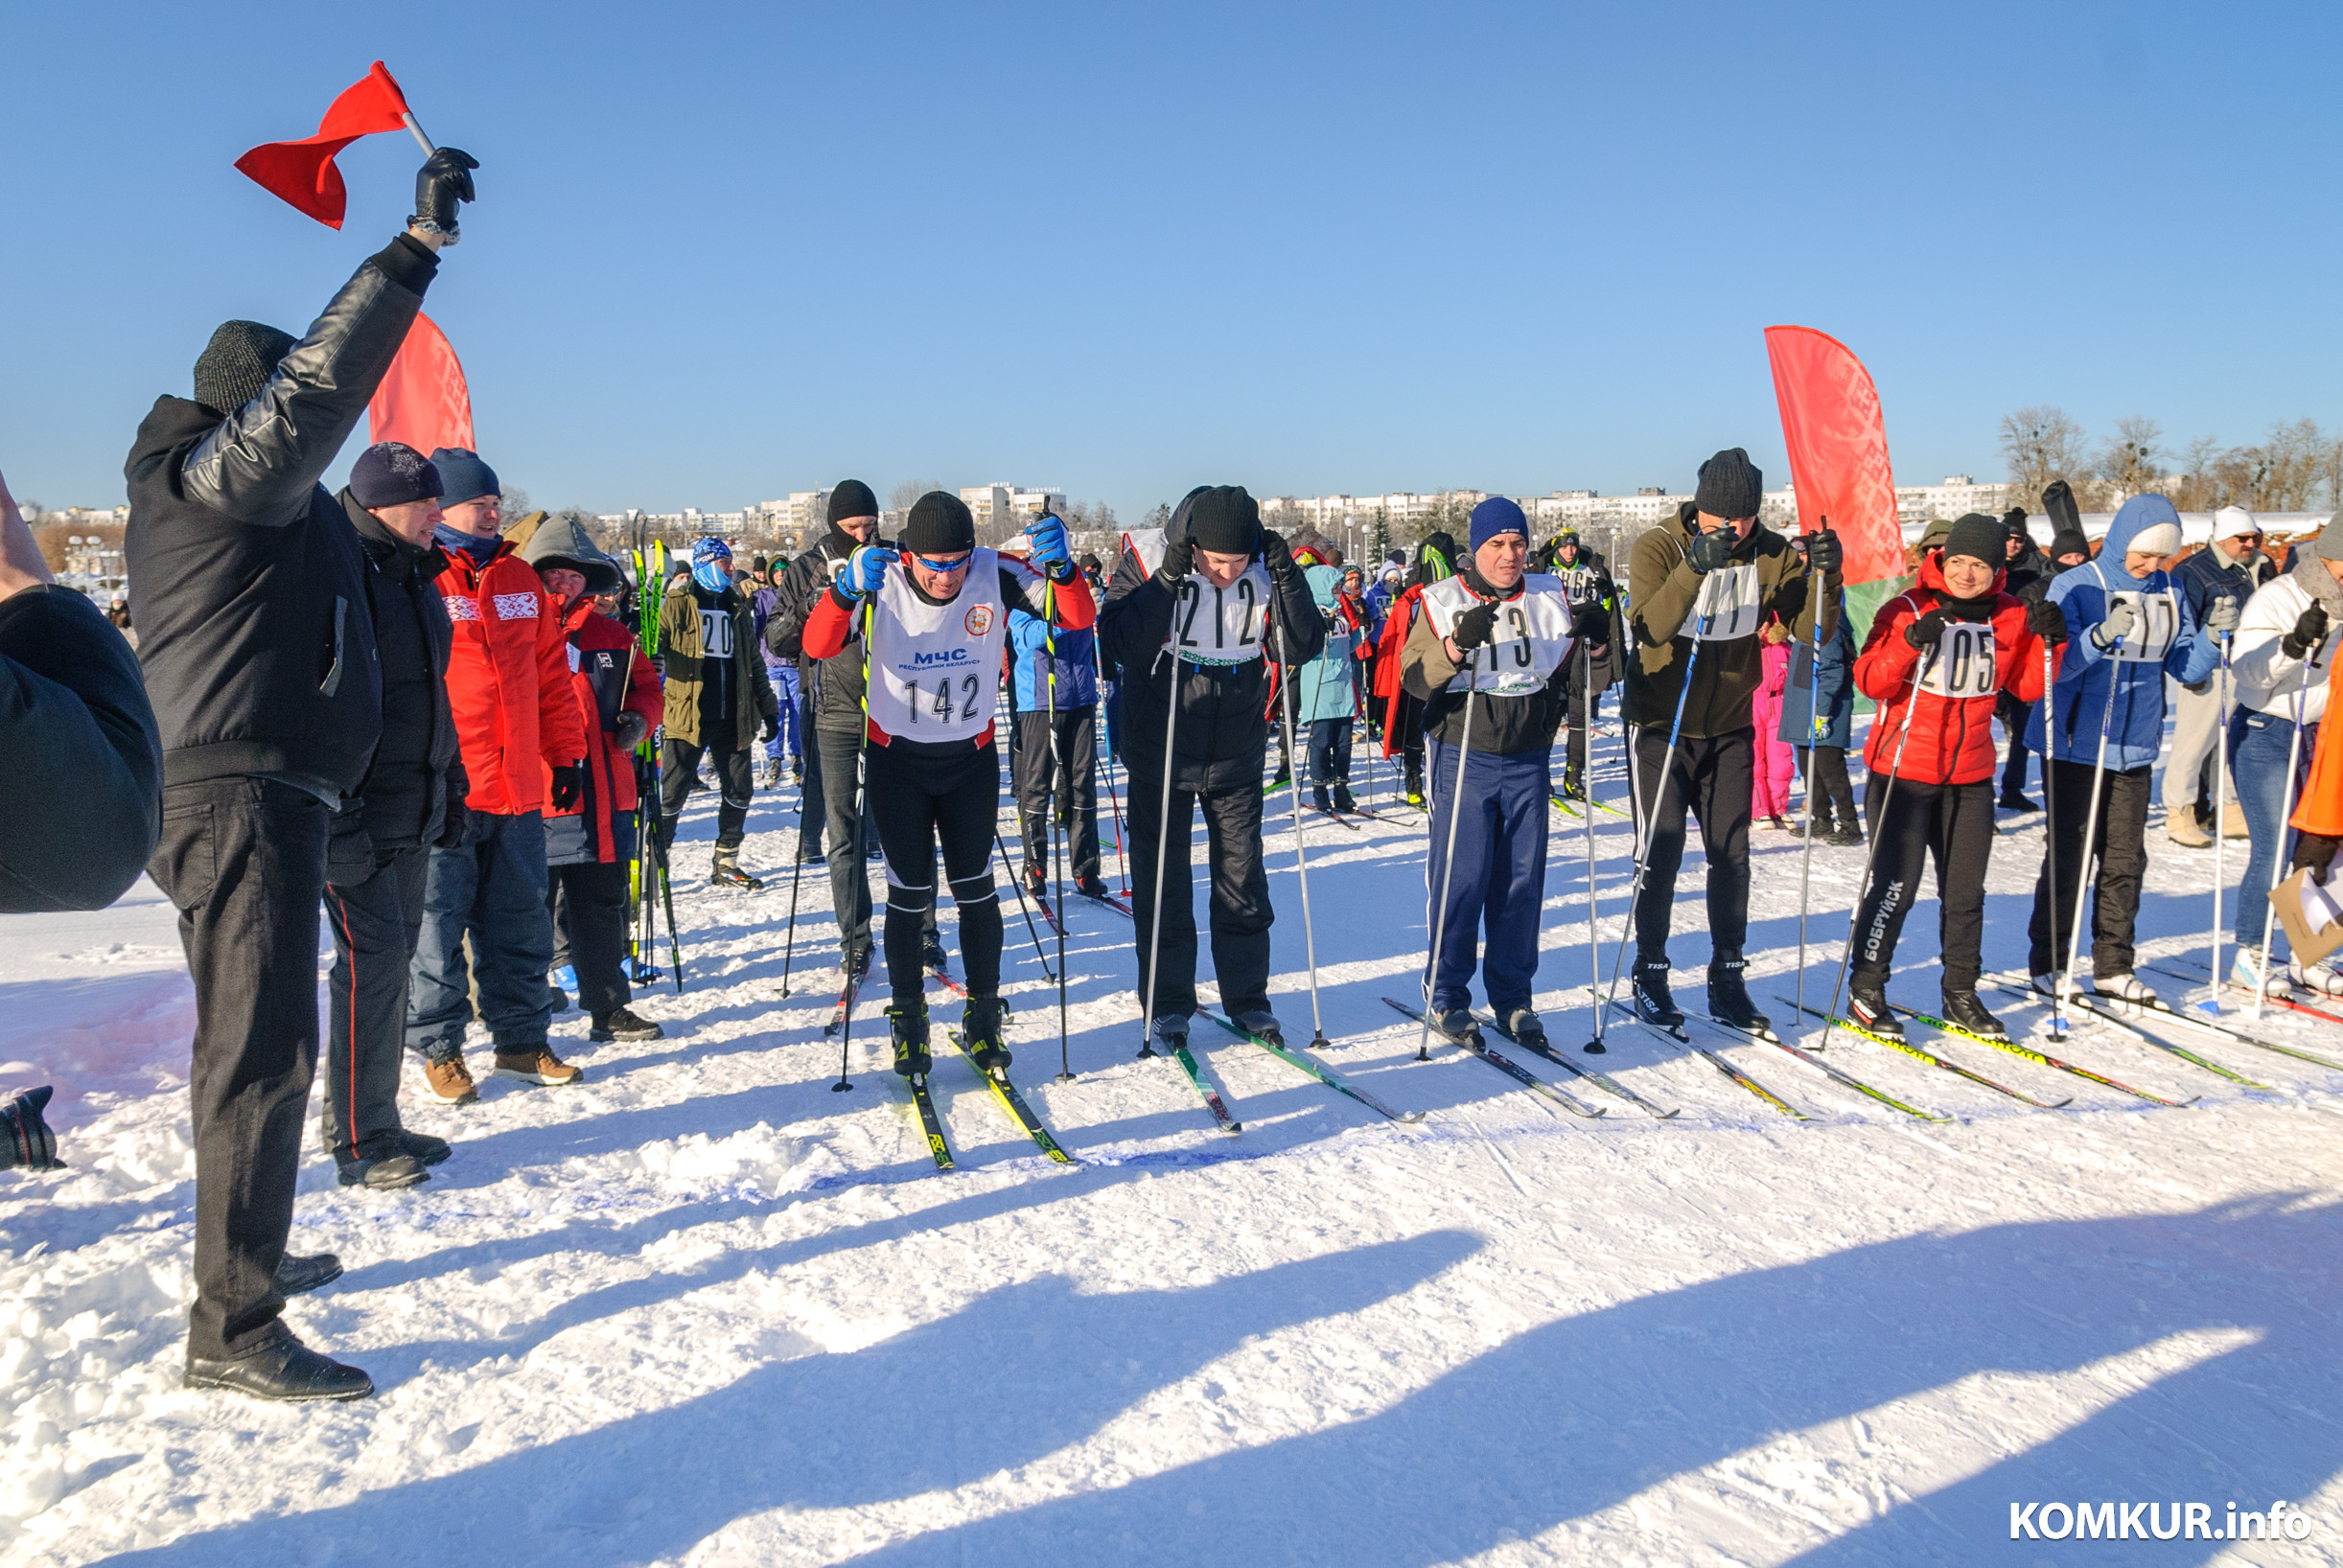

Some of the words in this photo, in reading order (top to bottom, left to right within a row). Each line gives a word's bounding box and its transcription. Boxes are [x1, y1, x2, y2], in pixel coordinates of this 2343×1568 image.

[1179, 578, 1255, 649] 212
[1451, 607, 1532, 672] 13
[915, 648, 967, 664] МЧС
[1919, 629, 1995, 693] 205
[905, 673, 980, 724] 142
[1864, 880, 1904, 961] БОБРУЙСК
[1640, 991, 1659, 1013] TISA
